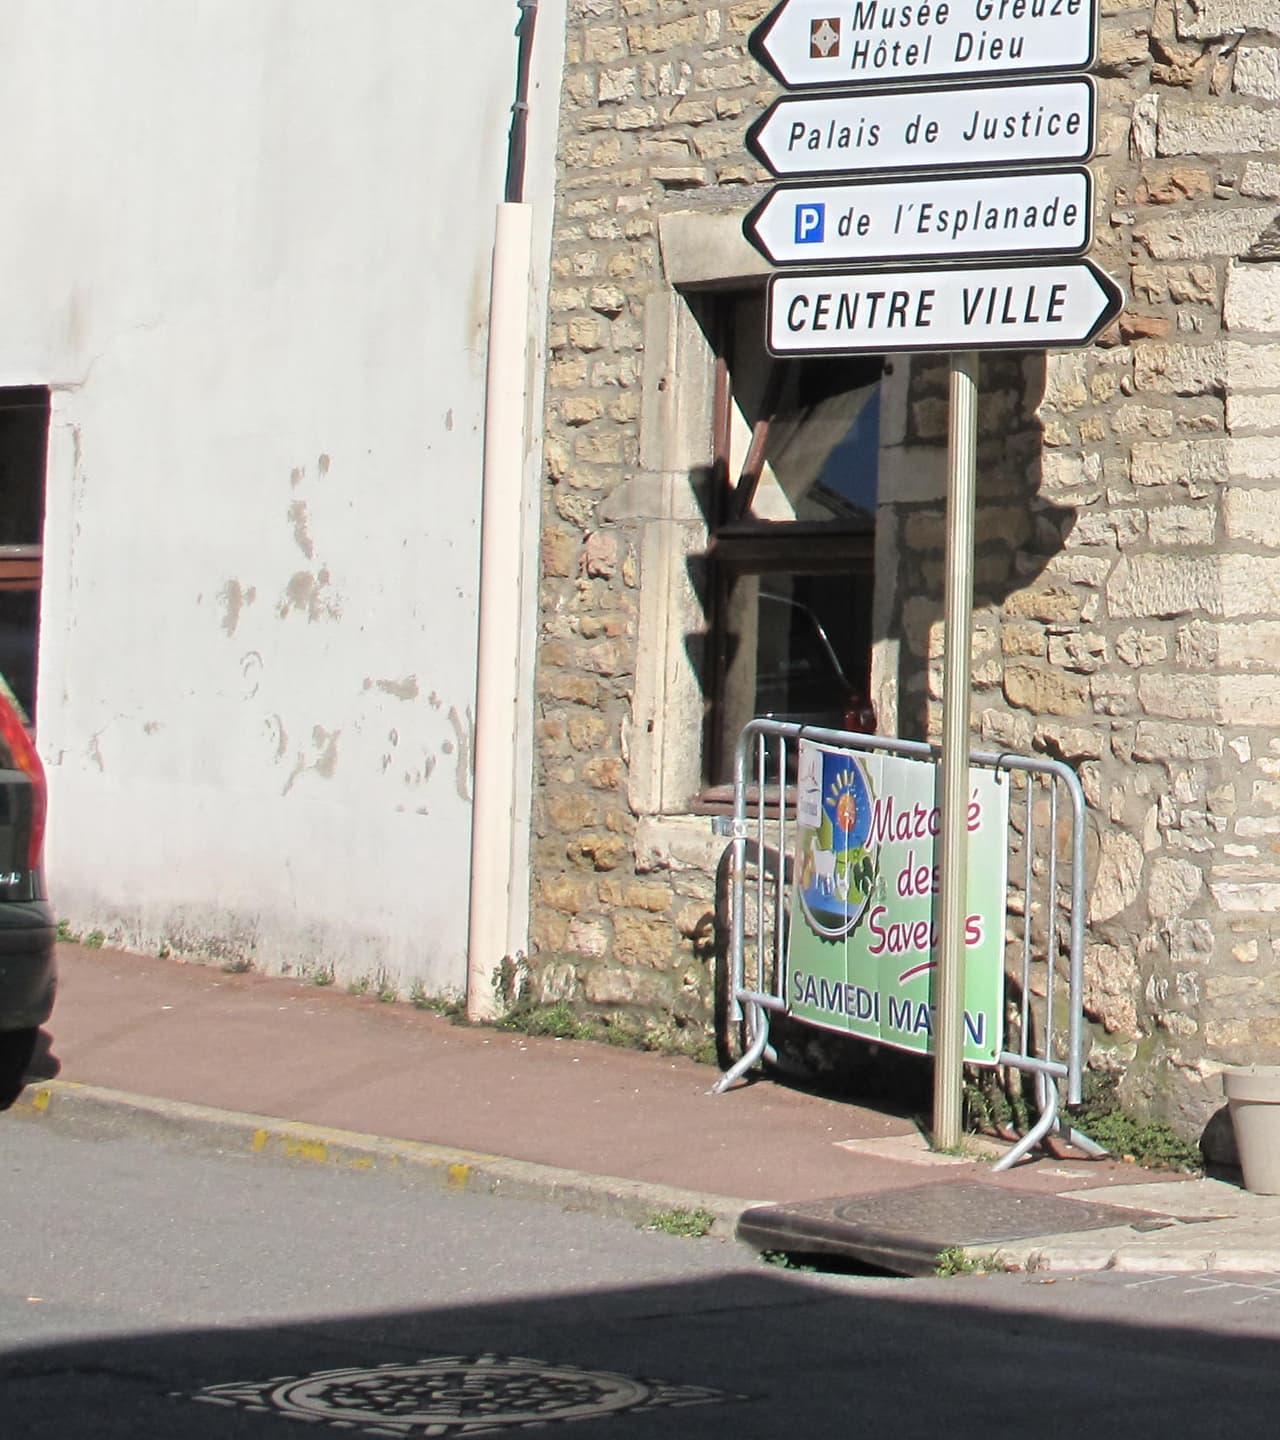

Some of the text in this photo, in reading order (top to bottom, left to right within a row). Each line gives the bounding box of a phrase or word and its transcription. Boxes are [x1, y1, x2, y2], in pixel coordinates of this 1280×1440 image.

[851, 31, 1024, 69] Hôtel Dieu
[788, 107, 1080, 151] Palais de Justice
[838, 207, 870, 236] de
[894, 197, 1077, 240] l'Esplanade
[787, 284, 1067, 332] CENTRE VILLE
[866, 788, 980, 849] Marcé
[793, 970, 984, 1046] SAMEDI MAN
